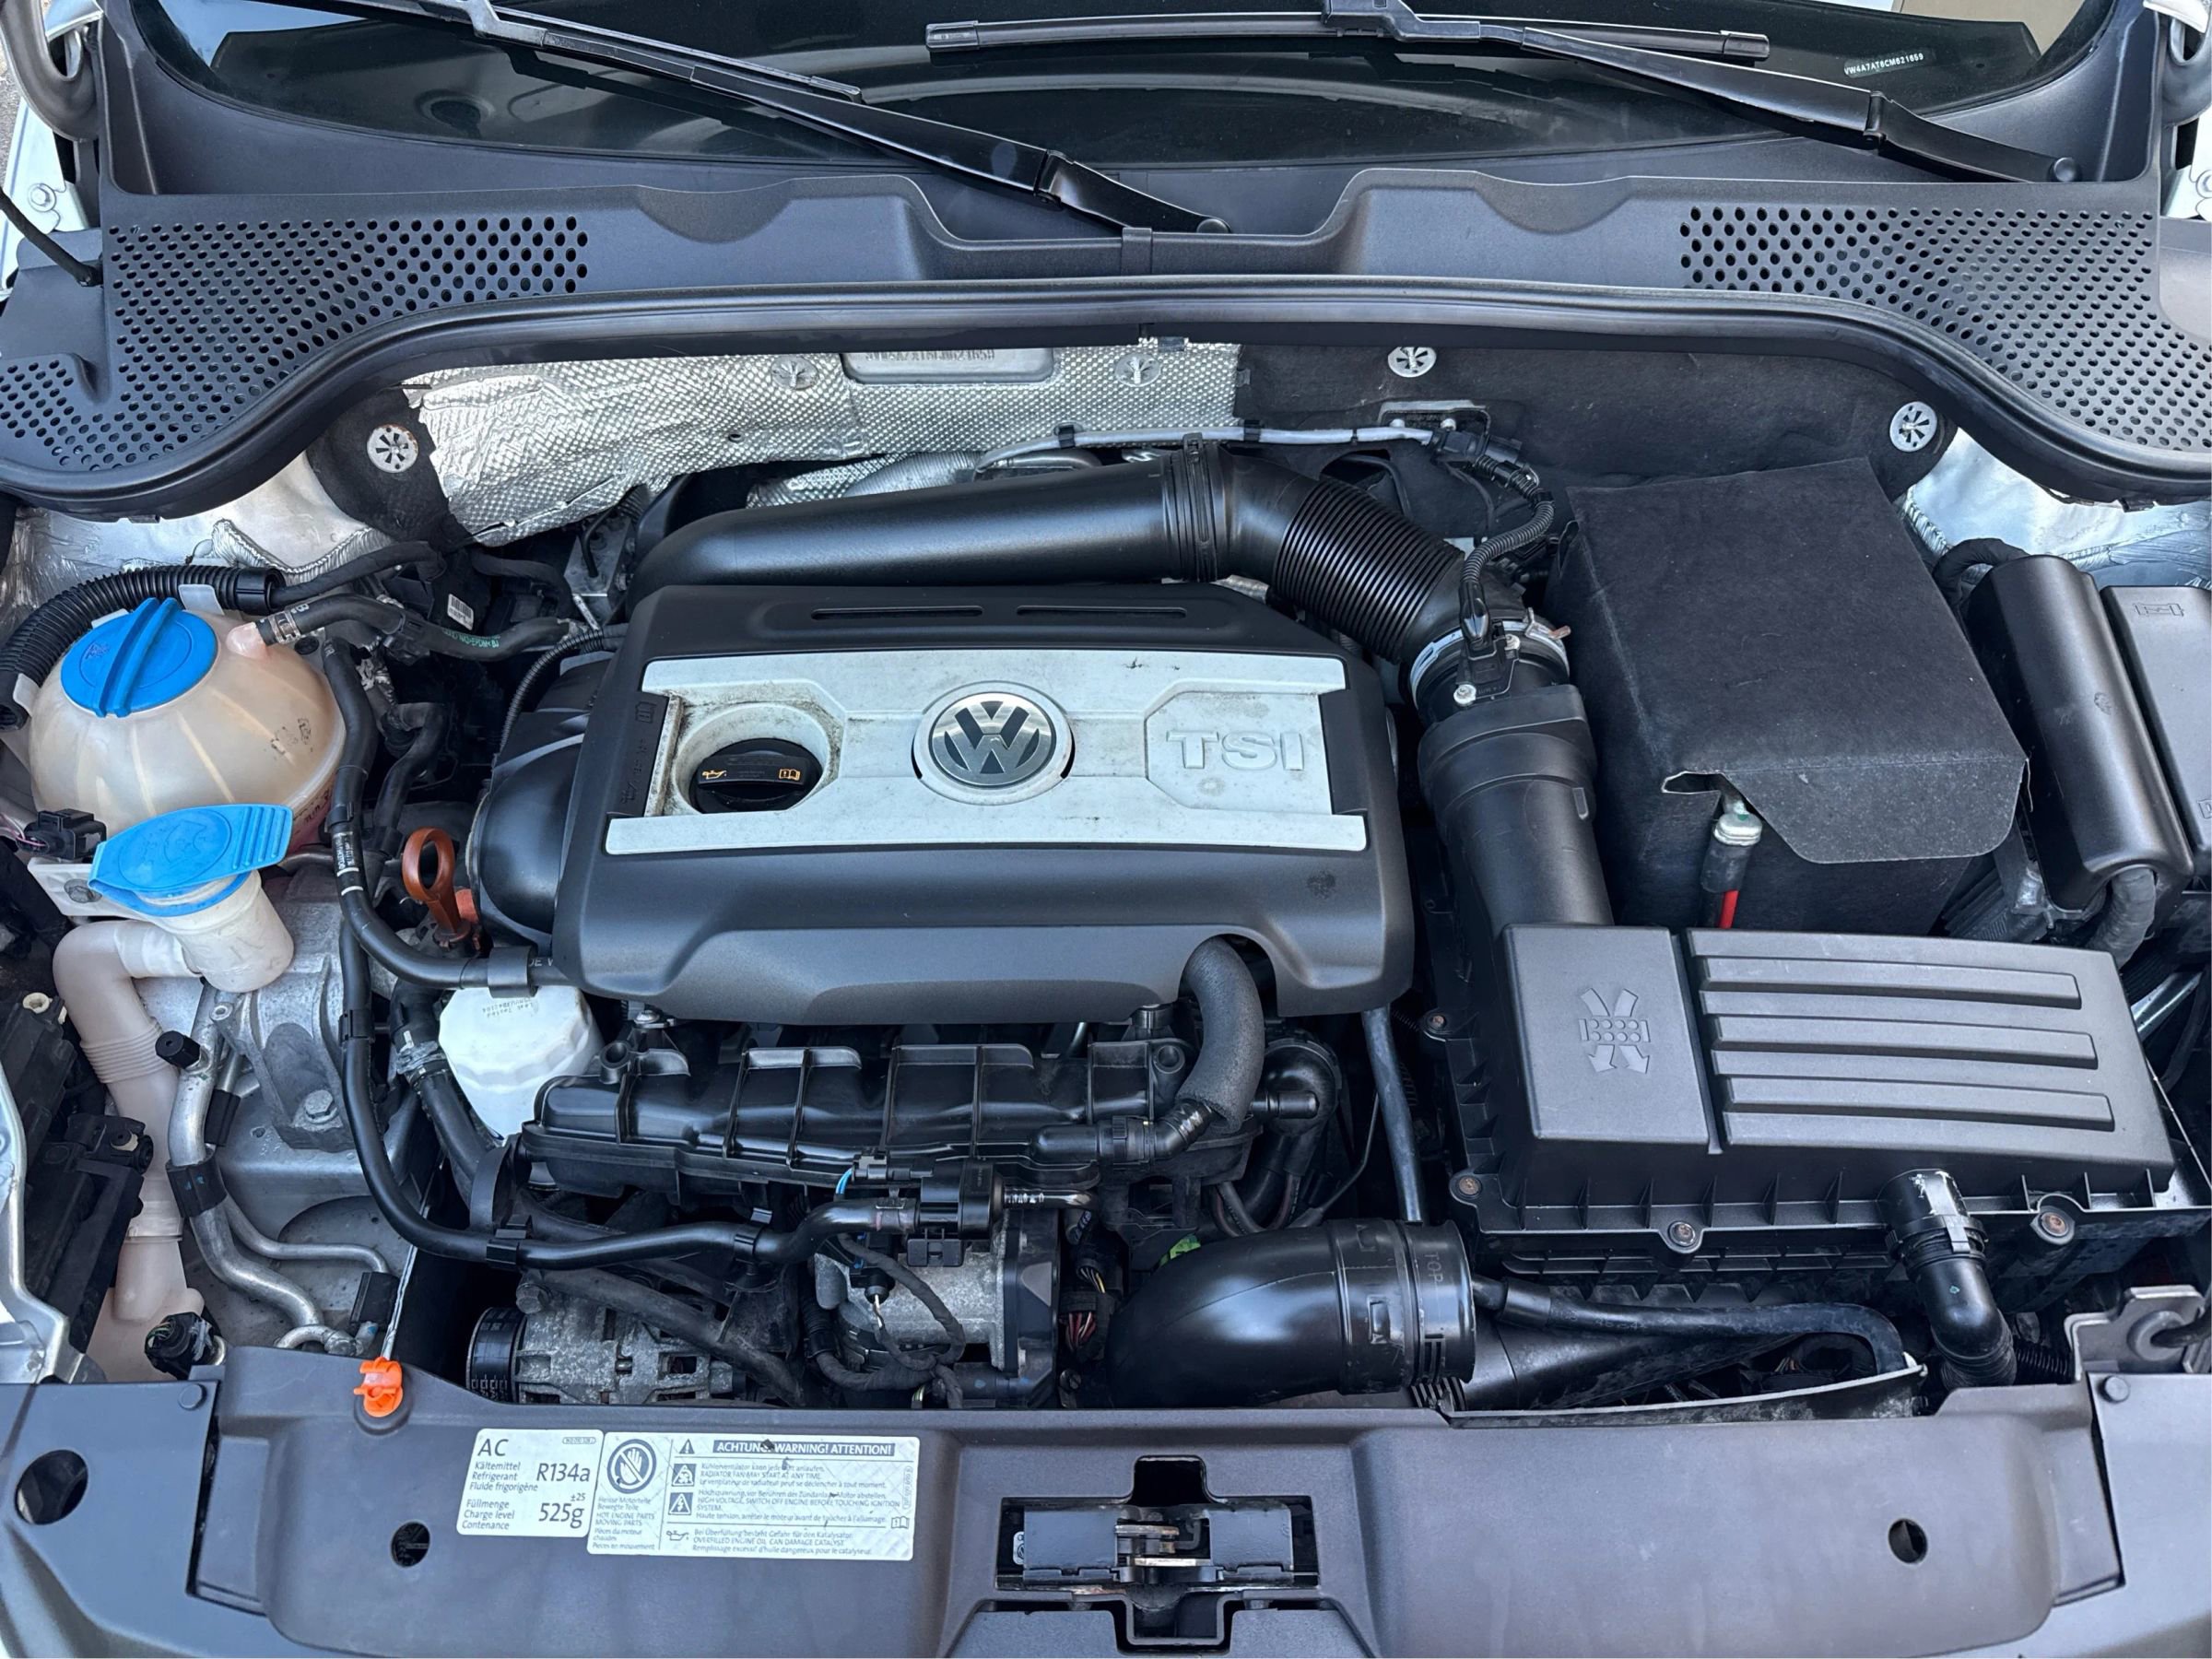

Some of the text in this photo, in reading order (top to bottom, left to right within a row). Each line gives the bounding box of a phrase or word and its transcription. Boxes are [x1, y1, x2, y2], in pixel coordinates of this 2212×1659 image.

[938, 698, 1049, 780] VW
[1167, 730, 1304, 771] TSI
[477, 1439, 509, 1456] AC
[717, 1441, 891, 1454] ACHTUN WARNING! ATTENTION!
[475, 1462, 520, 1471] Kältemittel
[536, 1463, 591, 1482] R134a
[472, 1473, 518, 1482] Refrigerant
[469, 1482, 538, 1493] Fluide frigorigène
[466, 1500, 509, 1510] Füllmenge
[465, 1510, 514, 1521] Charge level
[538, 1502, 584, 1528] 525g
[462, 1521, 509, 1530] Contenance
